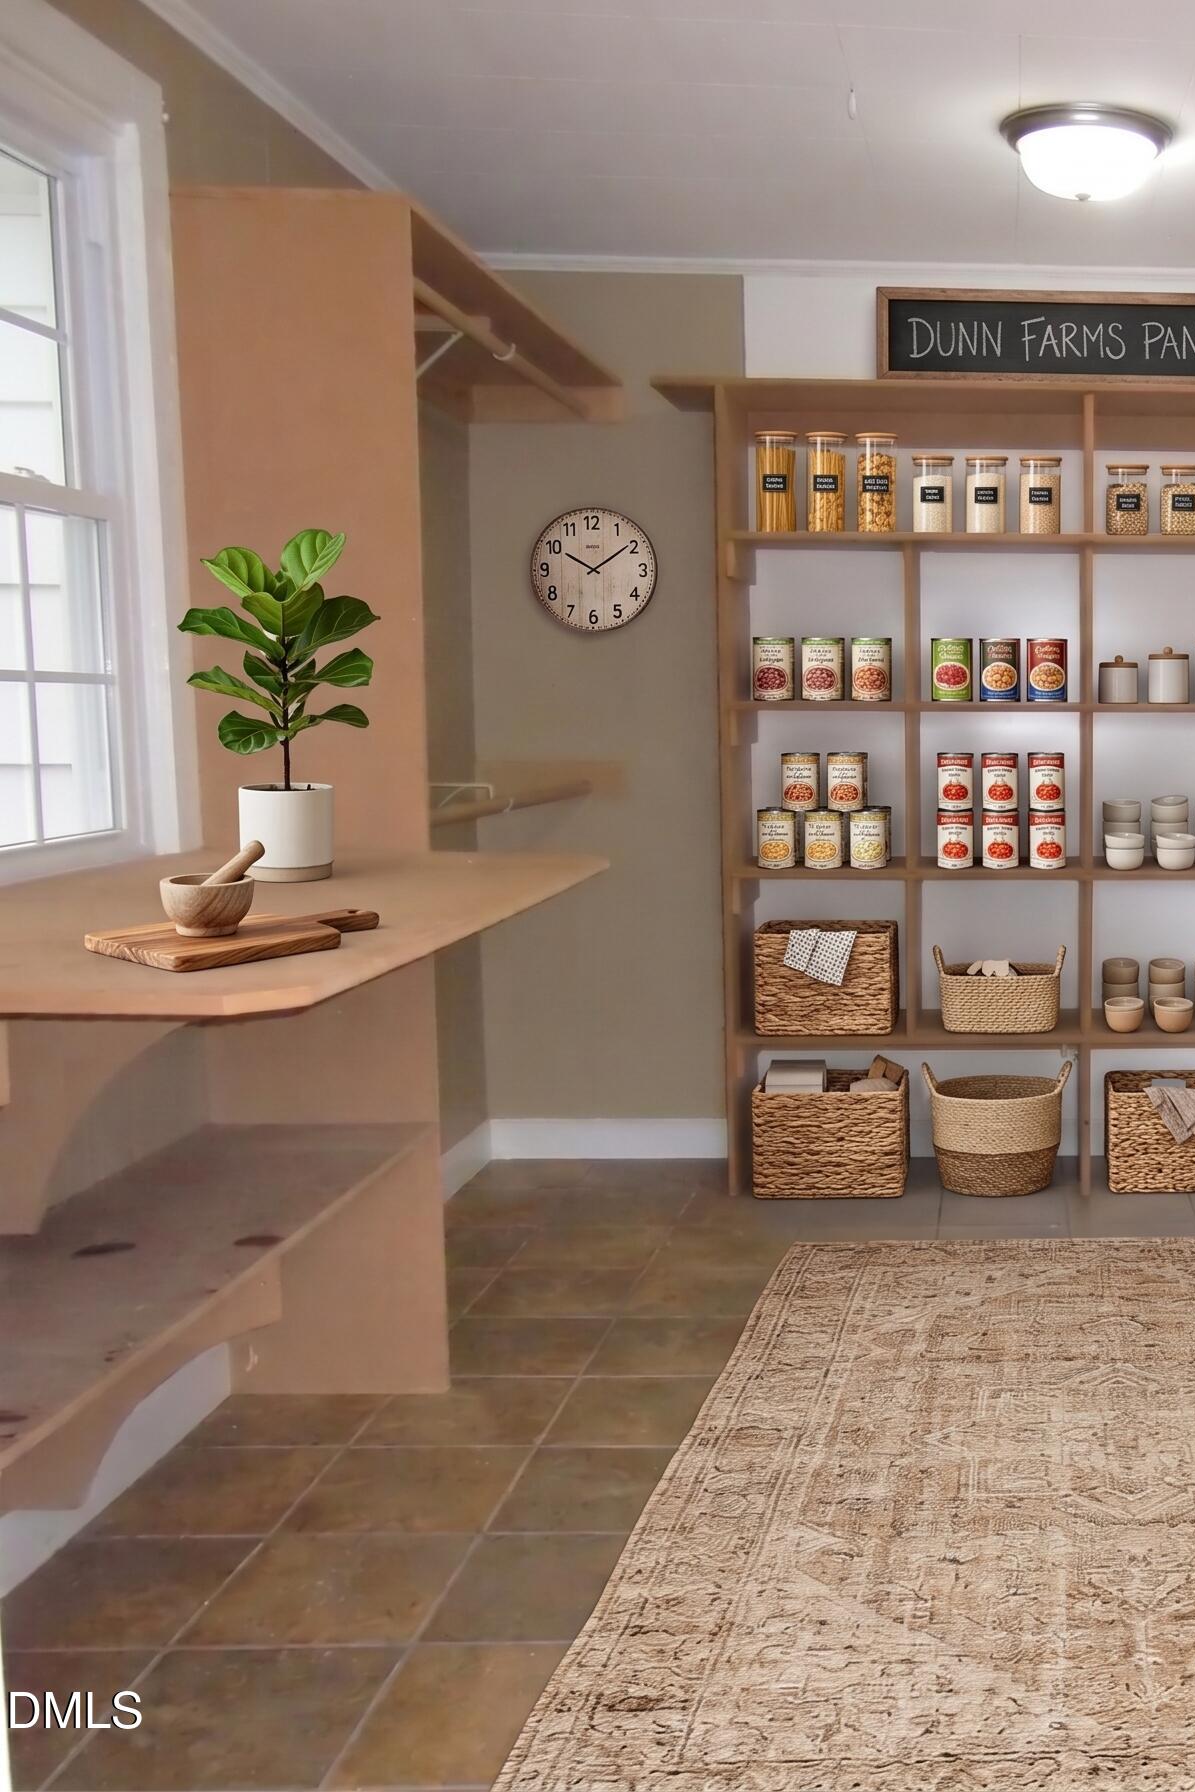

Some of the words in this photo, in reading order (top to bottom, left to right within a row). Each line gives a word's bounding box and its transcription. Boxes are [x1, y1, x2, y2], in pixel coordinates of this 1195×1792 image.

[907, 317, 1002, 358] DUNN
[1020, 316, 1126, 362] FARMS
[563, 522, 576, 536] 11
[583, 515, 600, 530] 12
[613, 522, 620, 536] 1
[545, 539, 562, 554] 10
[629, 539, 639, 554] 2
[540, 562, 550, 577] 9
[638, 562, 648, 577] 3
[547, 585, 558, 601] 8
[629, 586, 640, 601] 4
[566, 604, 575, 618] 7
[588, 609, 599, 624] 6
[612, 603, 622, 618] 5
